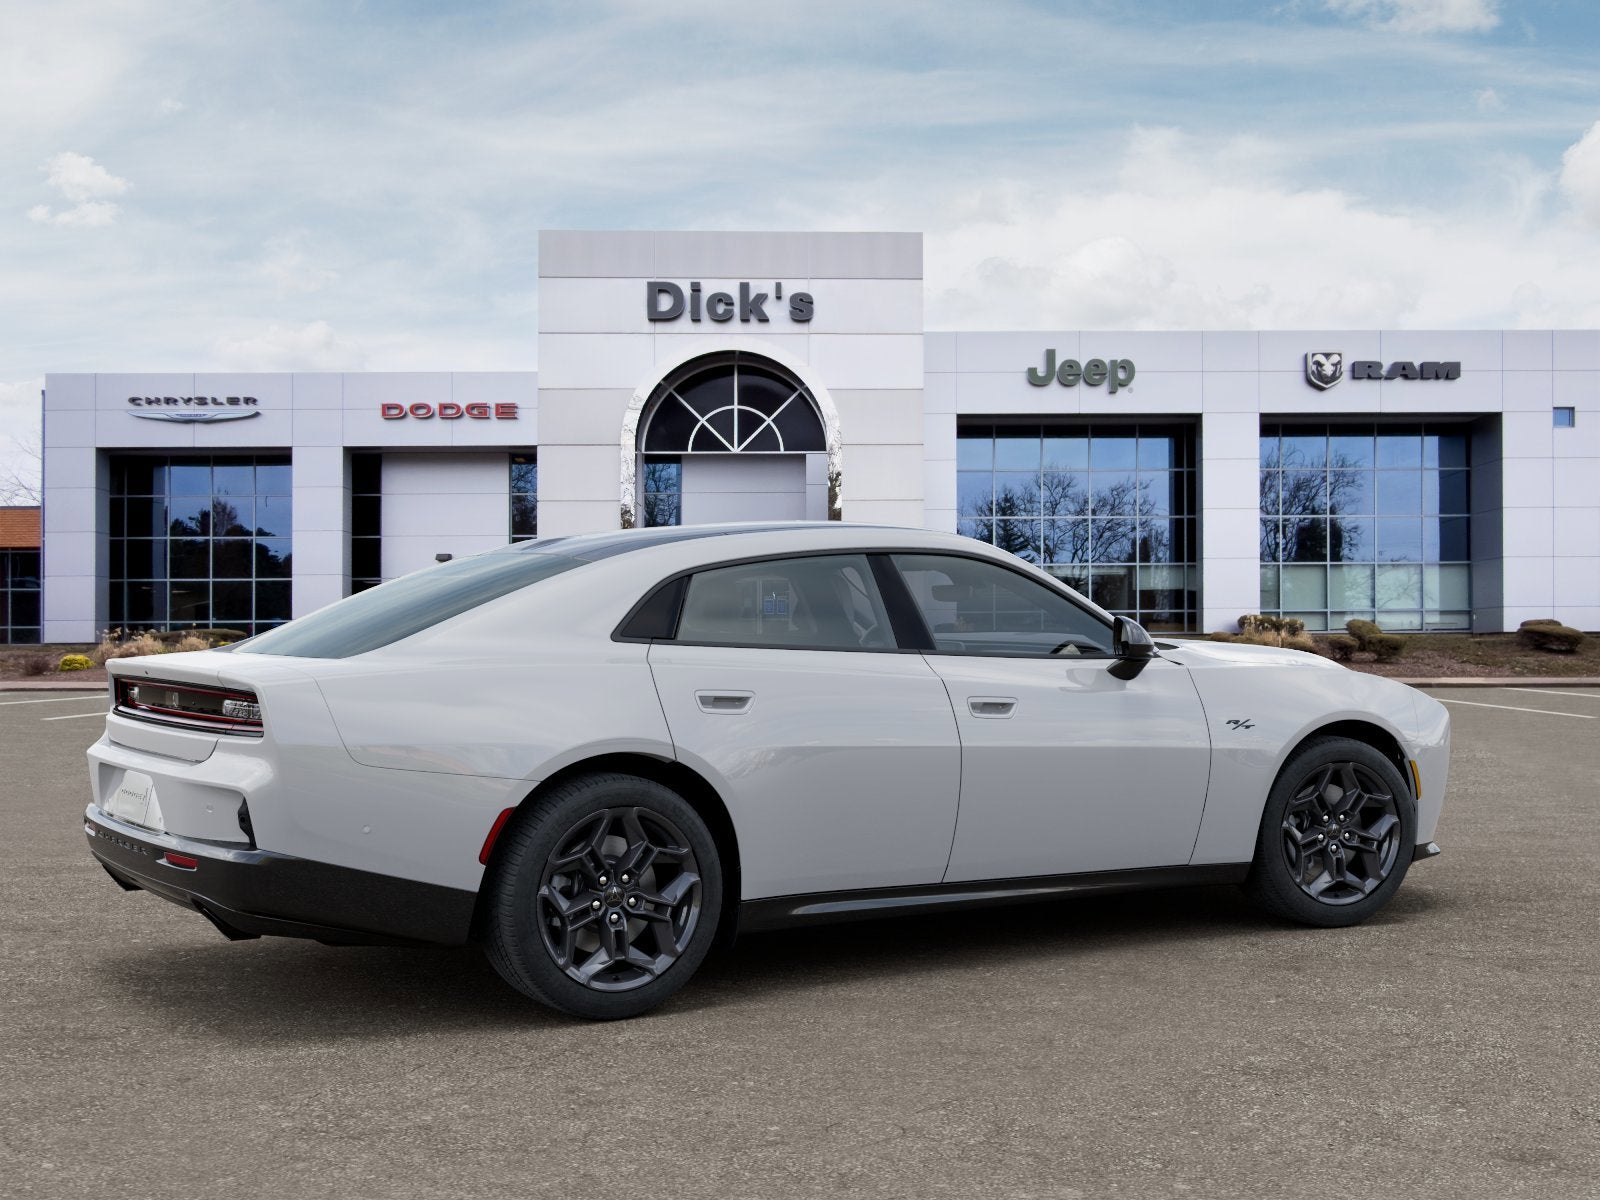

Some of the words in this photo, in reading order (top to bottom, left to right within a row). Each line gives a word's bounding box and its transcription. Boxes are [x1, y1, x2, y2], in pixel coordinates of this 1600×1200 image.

[647, 281, 814, 322] Dick's
[1027, 349, 1136, 394] Jeep
[1352, 360, 1461, 380] RAM
[128, 396, 258, 406] CHRYSLER
[381, 402, 518, 420] DODGE
[1226, 718, 1255, 730] R/T
